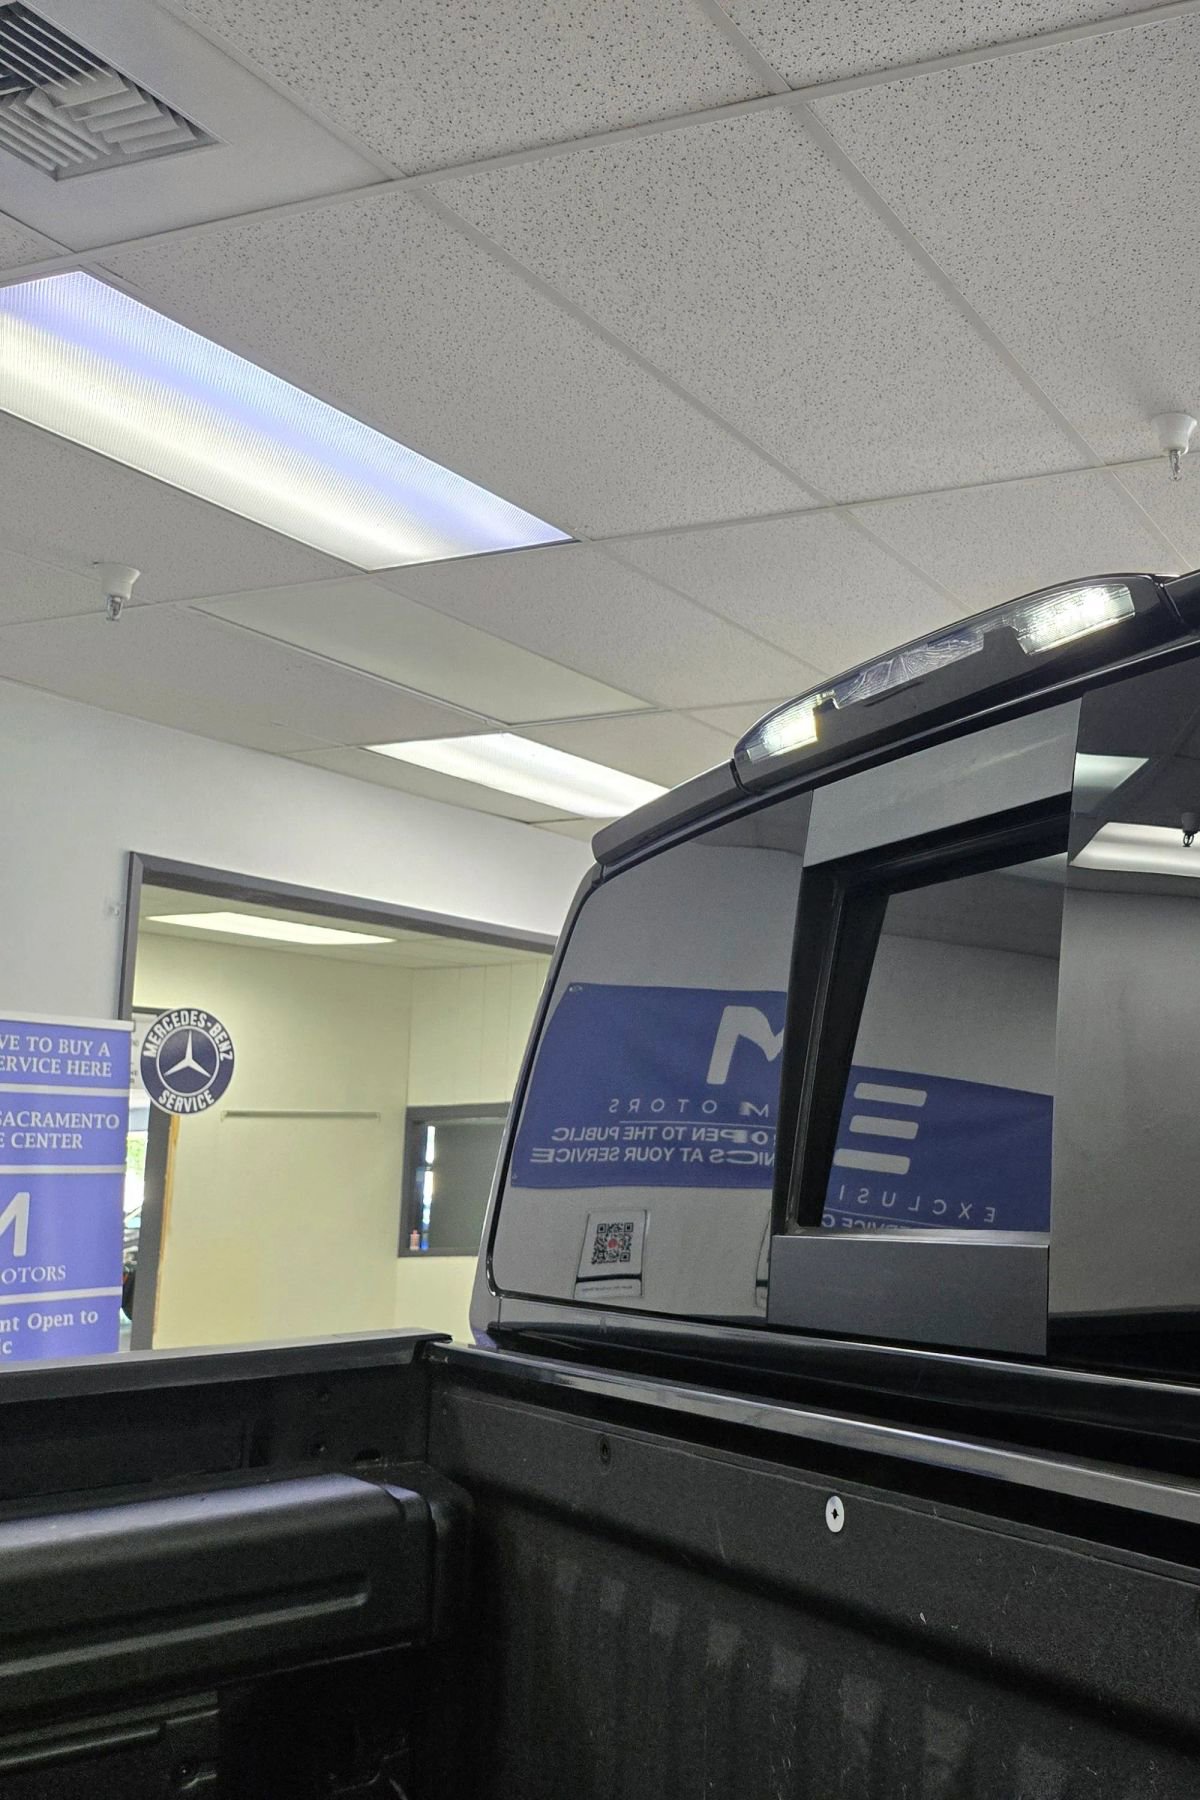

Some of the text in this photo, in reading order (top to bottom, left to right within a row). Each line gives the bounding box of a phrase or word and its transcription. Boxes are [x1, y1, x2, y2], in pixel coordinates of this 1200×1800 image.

[143, 1010, 233, 1061] MERCEDES-BENZ
[26, 1036, 53, 1053] TO
[58, 1038, 93, 1055] BUY
[98, 1042, 111, 1057] A
[66, 1060, 112, 1078] HERE
[158, 1090, 215, 1113] SERVICE
[0, 1111, 120, 1129] ACRAMENTO
[11, 1132, 83, 1149] CENTER
[27, 1312, 74, 1332] Open
[80, 1310, 99, 1325] to
